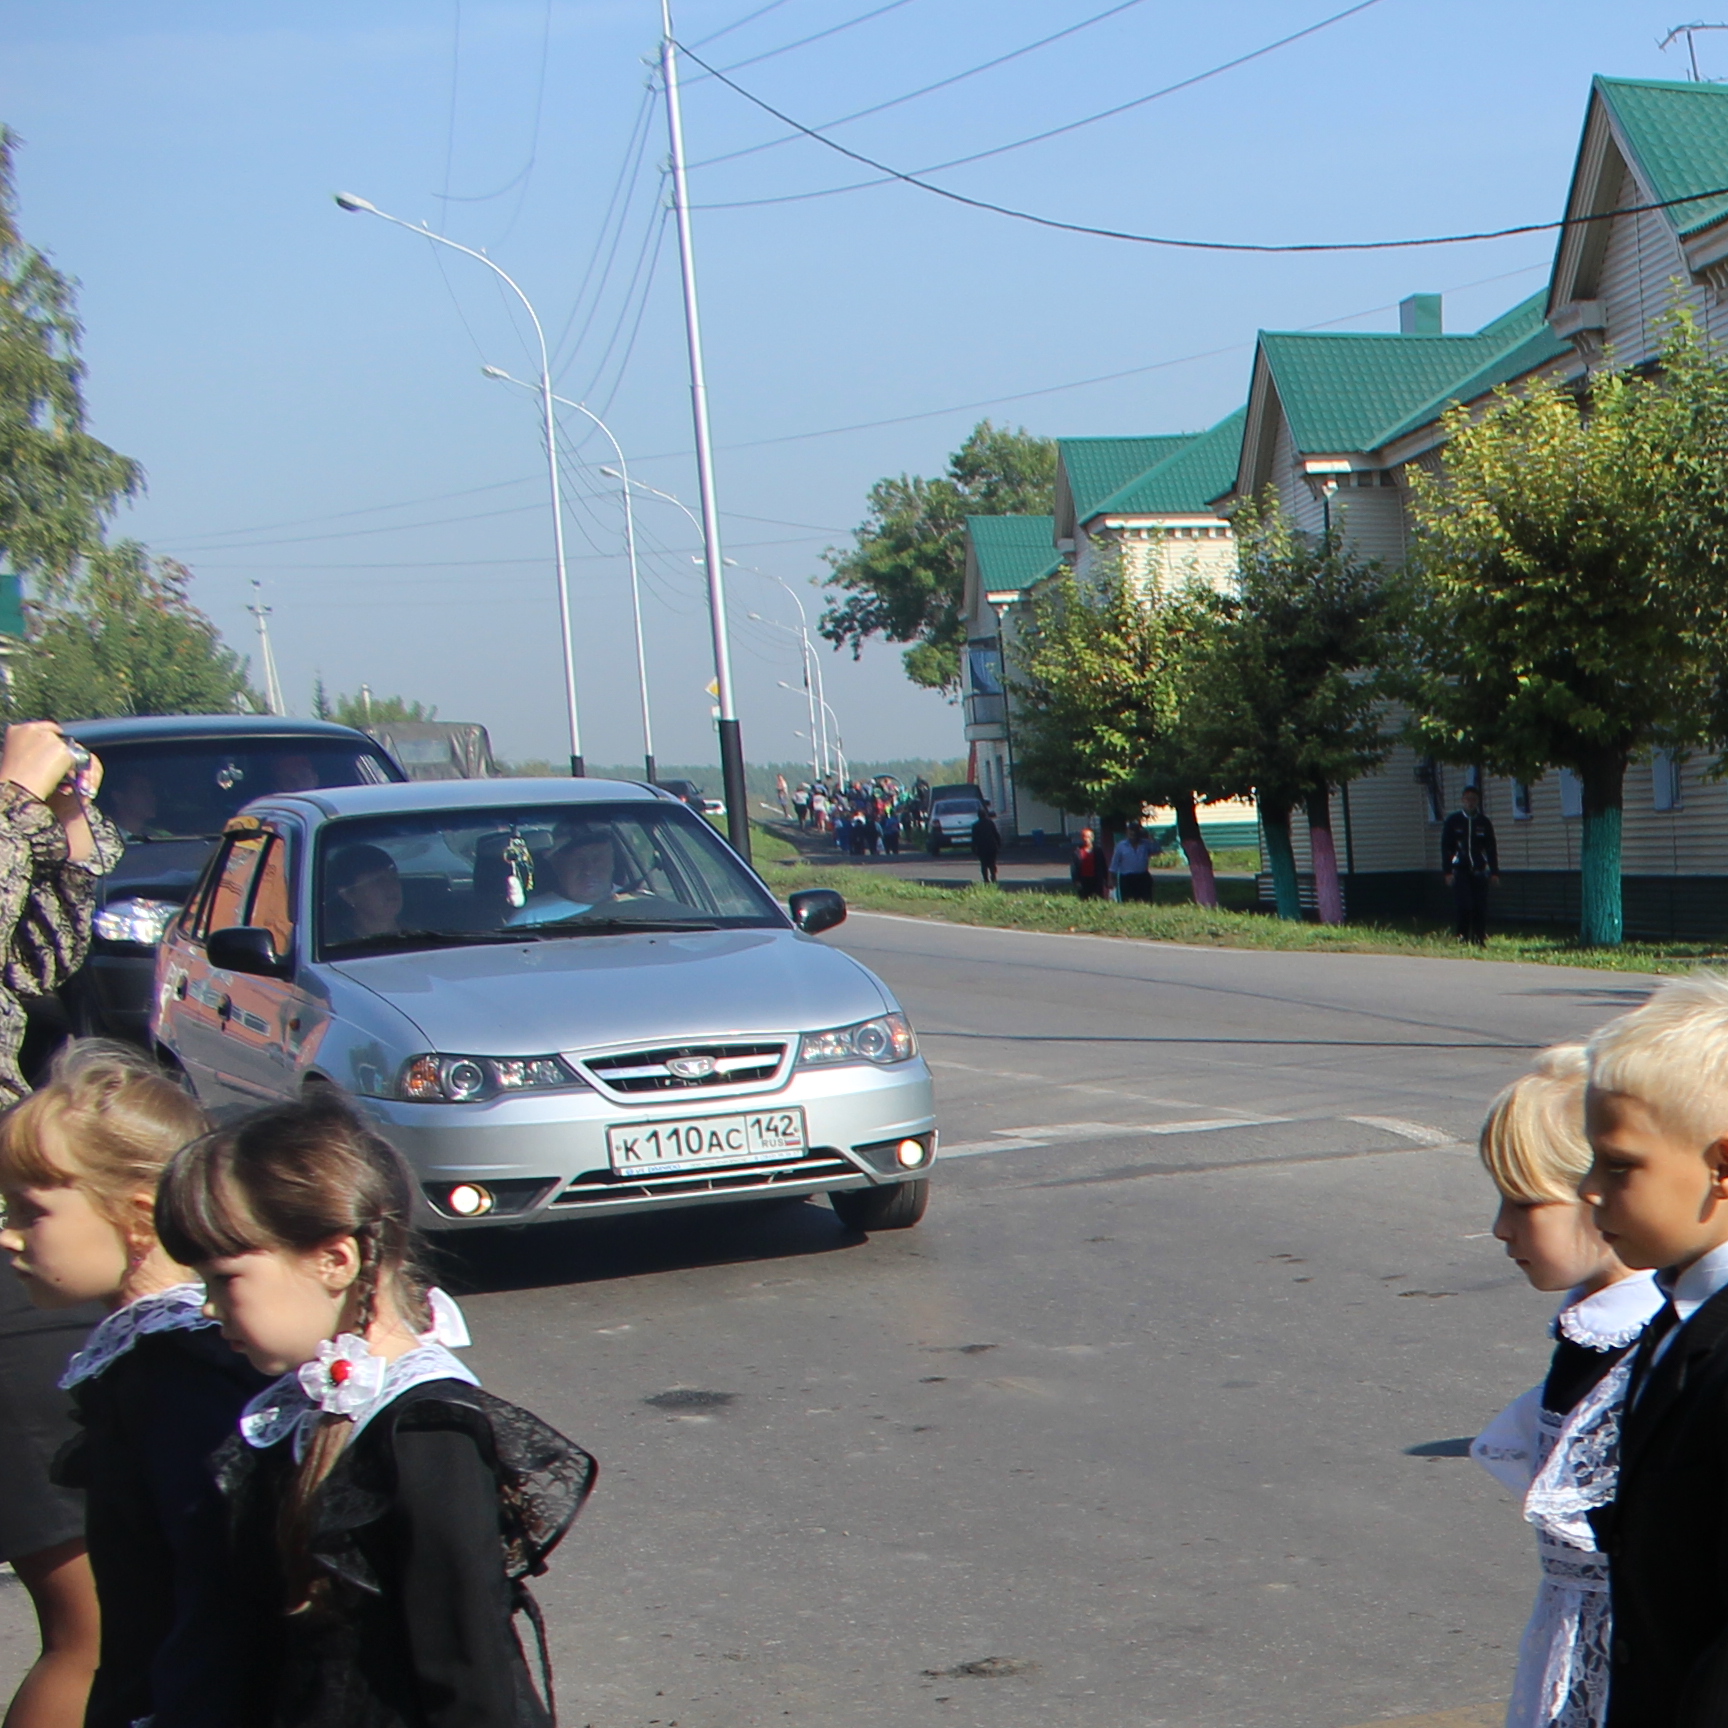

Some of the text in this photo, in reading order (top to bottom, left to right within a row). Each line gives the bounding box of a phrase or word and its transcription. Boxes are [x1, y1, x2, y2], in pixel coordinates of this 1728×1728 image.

[623, 1125, 743, 1162] К110АС
[750, 1114, 795, 1139] 142
[761, 1137, 786, 1148] RUS
